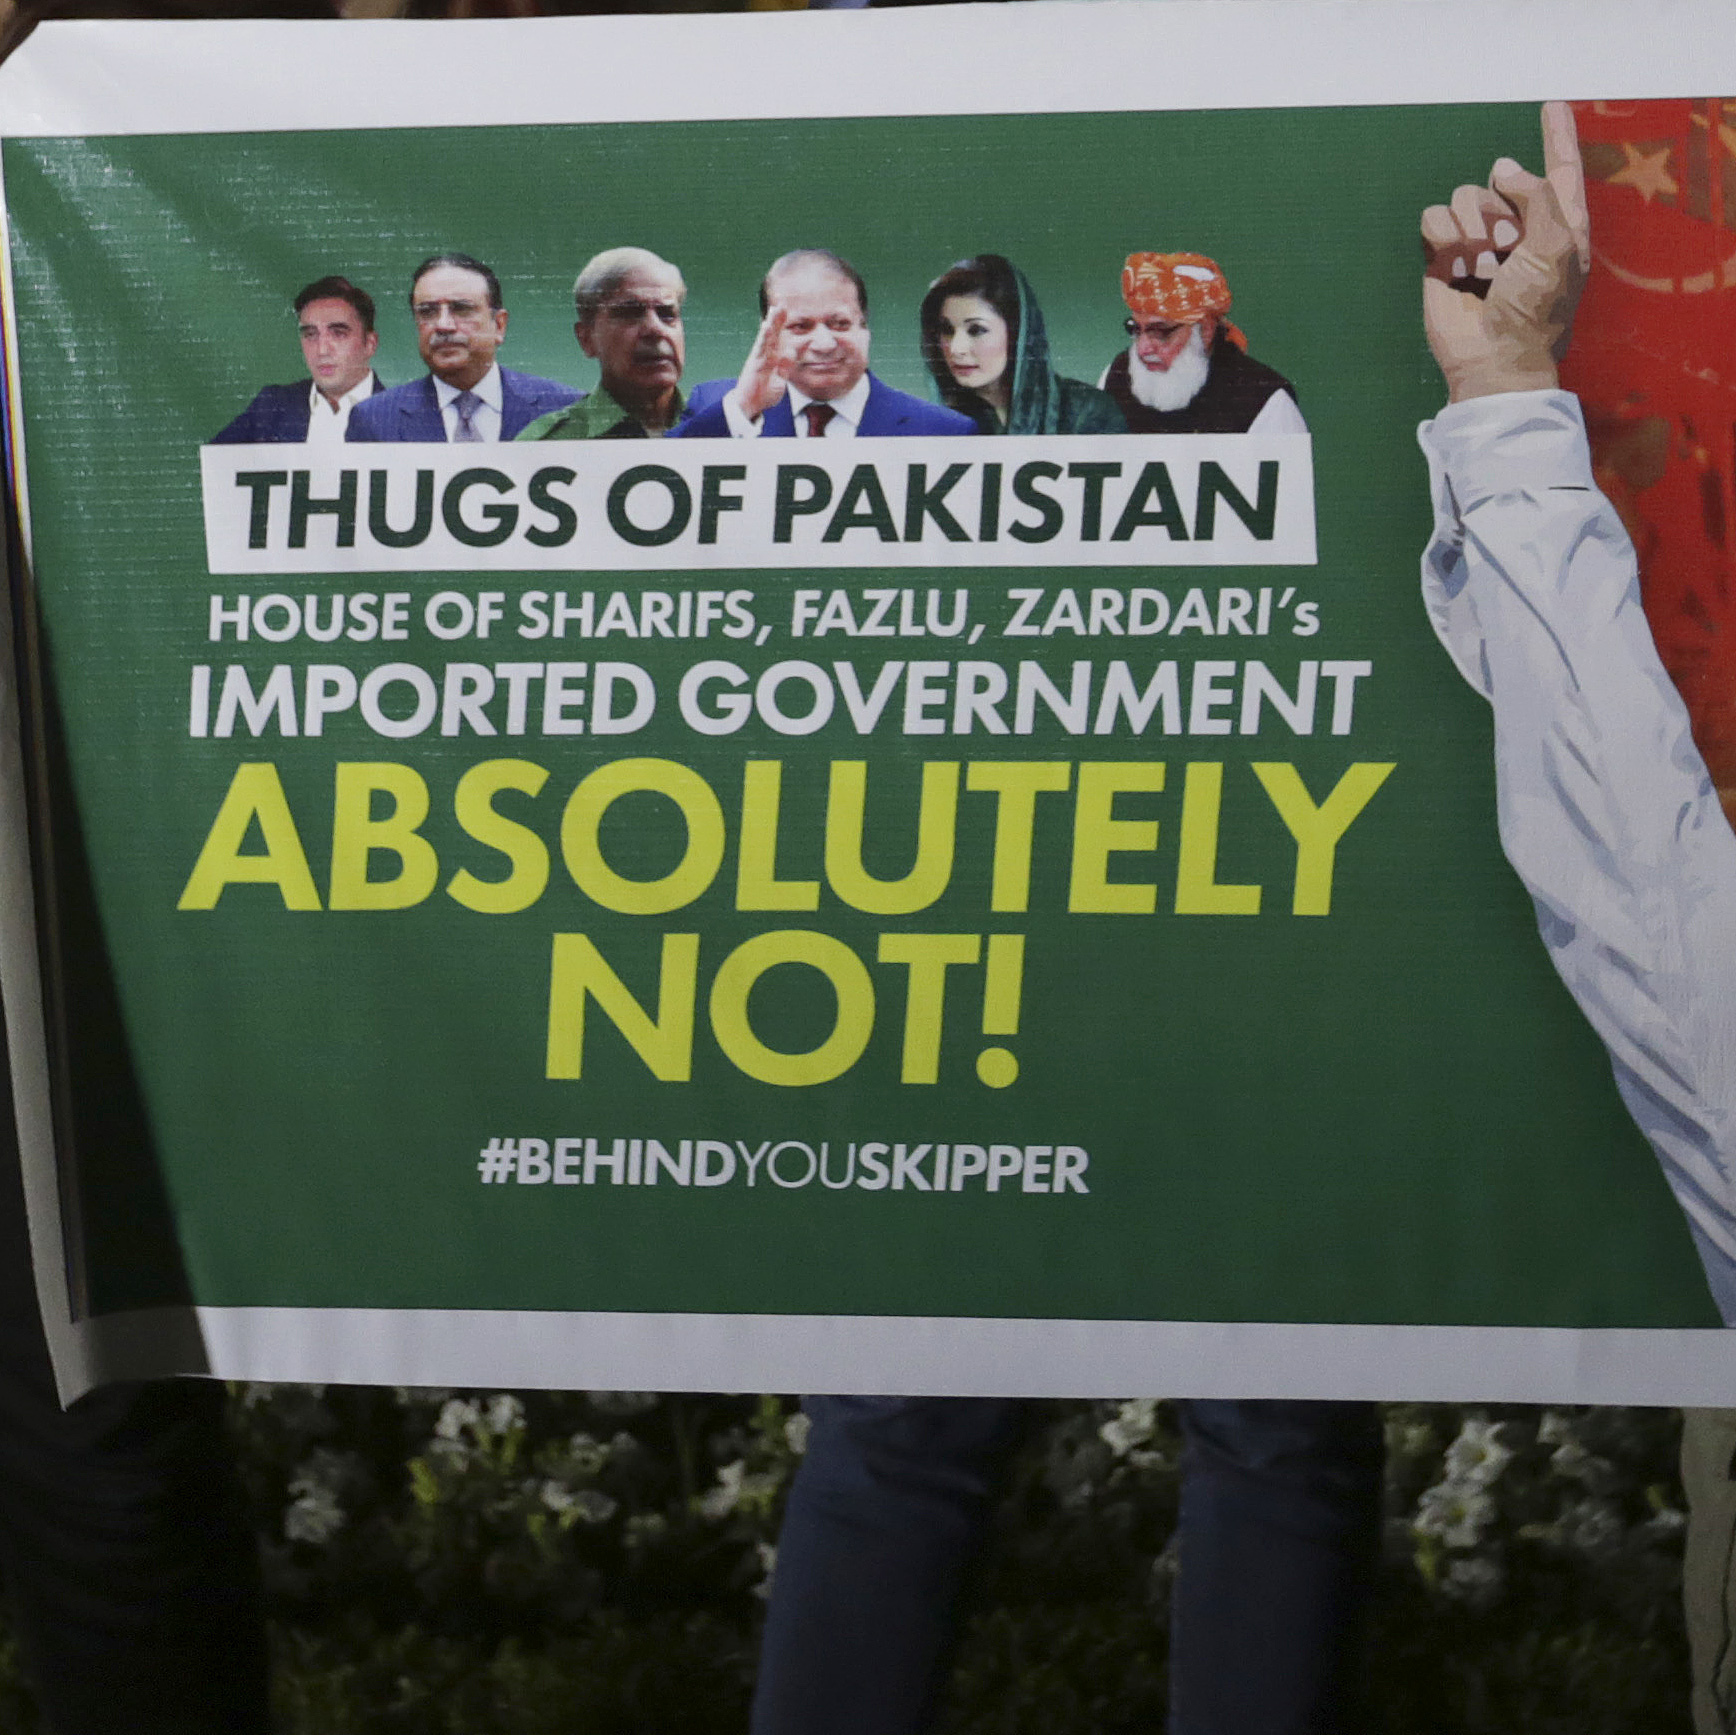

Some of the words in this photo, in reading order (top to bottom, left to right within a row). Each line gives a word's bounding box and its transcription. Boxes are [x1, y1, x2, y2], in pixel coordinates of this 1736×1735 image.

[234, 466, 579, 551] THUGS
[605, 463, 748, 548] OF
[771, 459, 1281, 545] PAKISTAN
[207, 591, 412, 643] HOUSE
[423, 589, 507, 642] OF
[516, 588, 774, 648] SHARIFS,
[790, 587, 987, 646] FAZLU,
[1001, 586, 1321, 638] ZARDARI's
[188, 660, 657, 739] IMPORTED
[677, 658, 1374, 737] GOVERNMENT
[176, 756, 1398, 917] ABSOLUTELY
[545, 928, 1026, 1090] NOT!
[476, 1136, 1091, 1195] #BEHINDYOUSKIPPER
